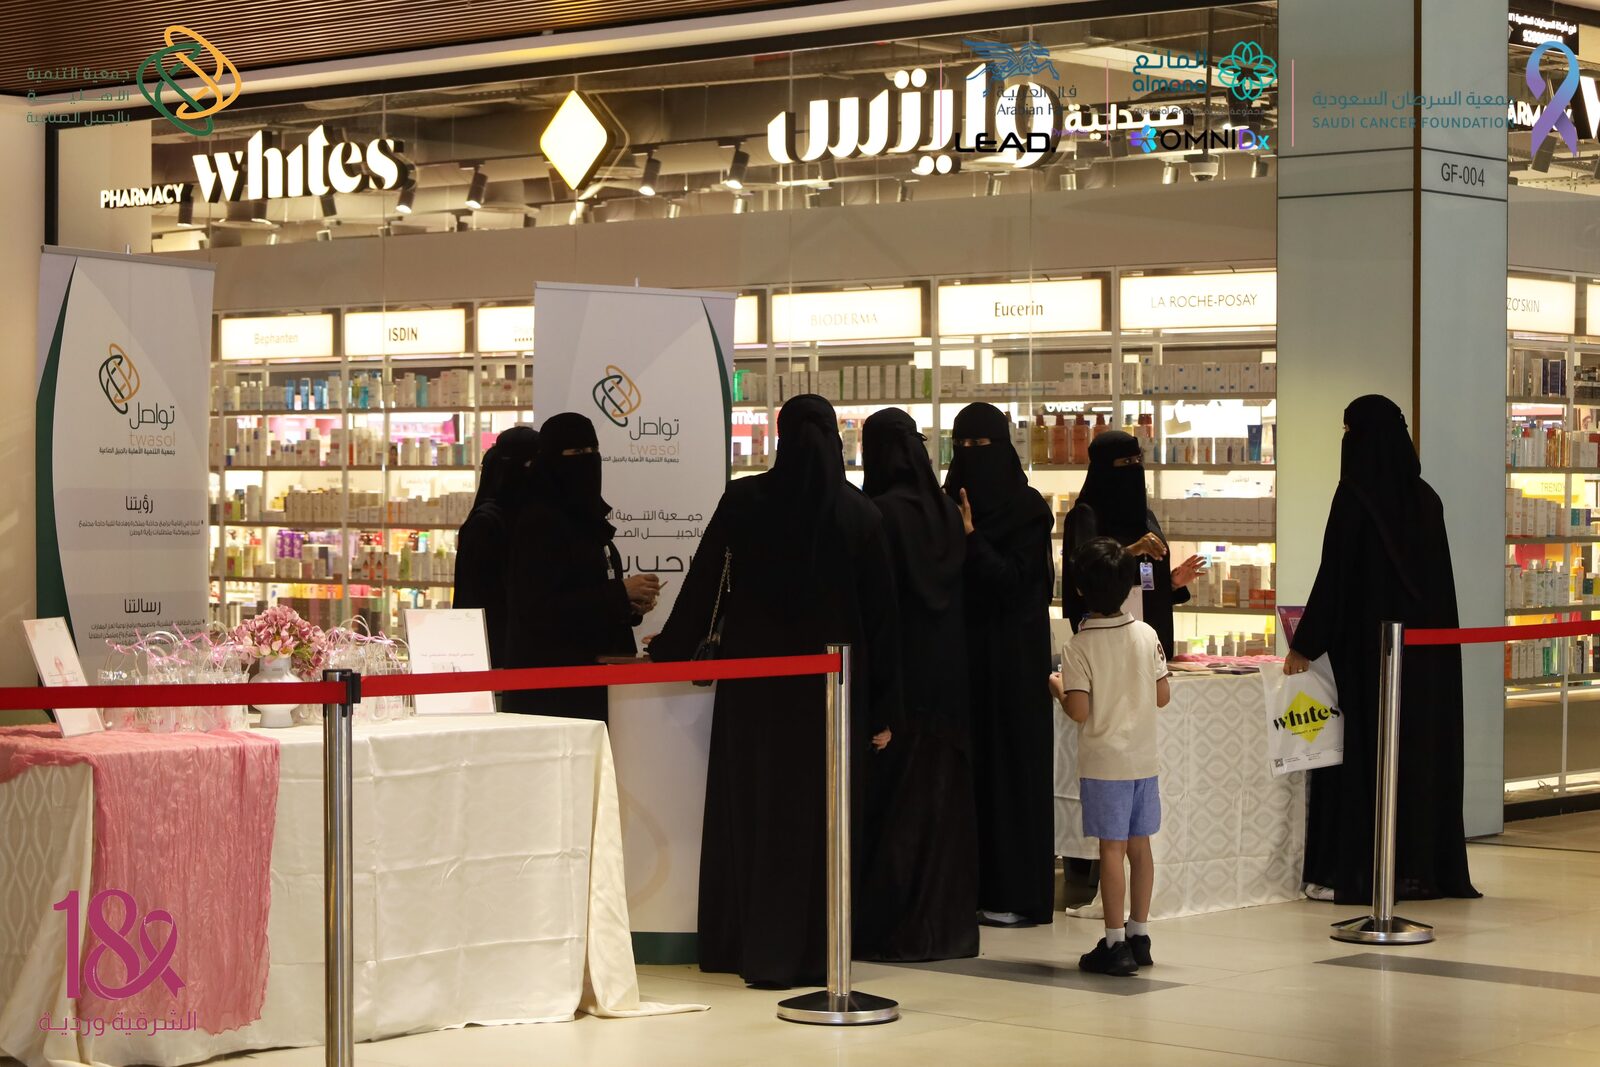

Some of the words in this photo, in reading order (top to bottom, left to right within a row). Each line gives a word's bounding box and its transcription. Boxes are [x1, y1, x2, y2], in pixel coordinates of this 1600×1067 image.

[1064, 103, 1184, 140] صيدلية
[100, 183, 184, 208] PHARMACY
[192, 124, 399, 202] whites
[1441, 163, 1485, 187] GF-004
[994, 300, 1044, 317] Eucerin
[1151, 295, 1166, 309] LA
[1169, 293, 1258, 308] ROCHE-POSAY
[1521, 298, 1540, 312] SKIN
[810, 312, 879, 326] BIODERMA
[388, 327, 418, 341] ISDIN
[129, 402, 175, 430] تواصل
[629, 416, 680, 441] تواصل
[129, 432, 176, 447] twasol
[629, 441, 680, 456] twasol
[125, 494, 154, 514] رؤيتنا
[615, 509, 656, 523] التنمية
[658, 509, 703, 523] جمعية
[124, 598, 161, 616] رسالتنا
[1273, 705, 1340, 731] whites
